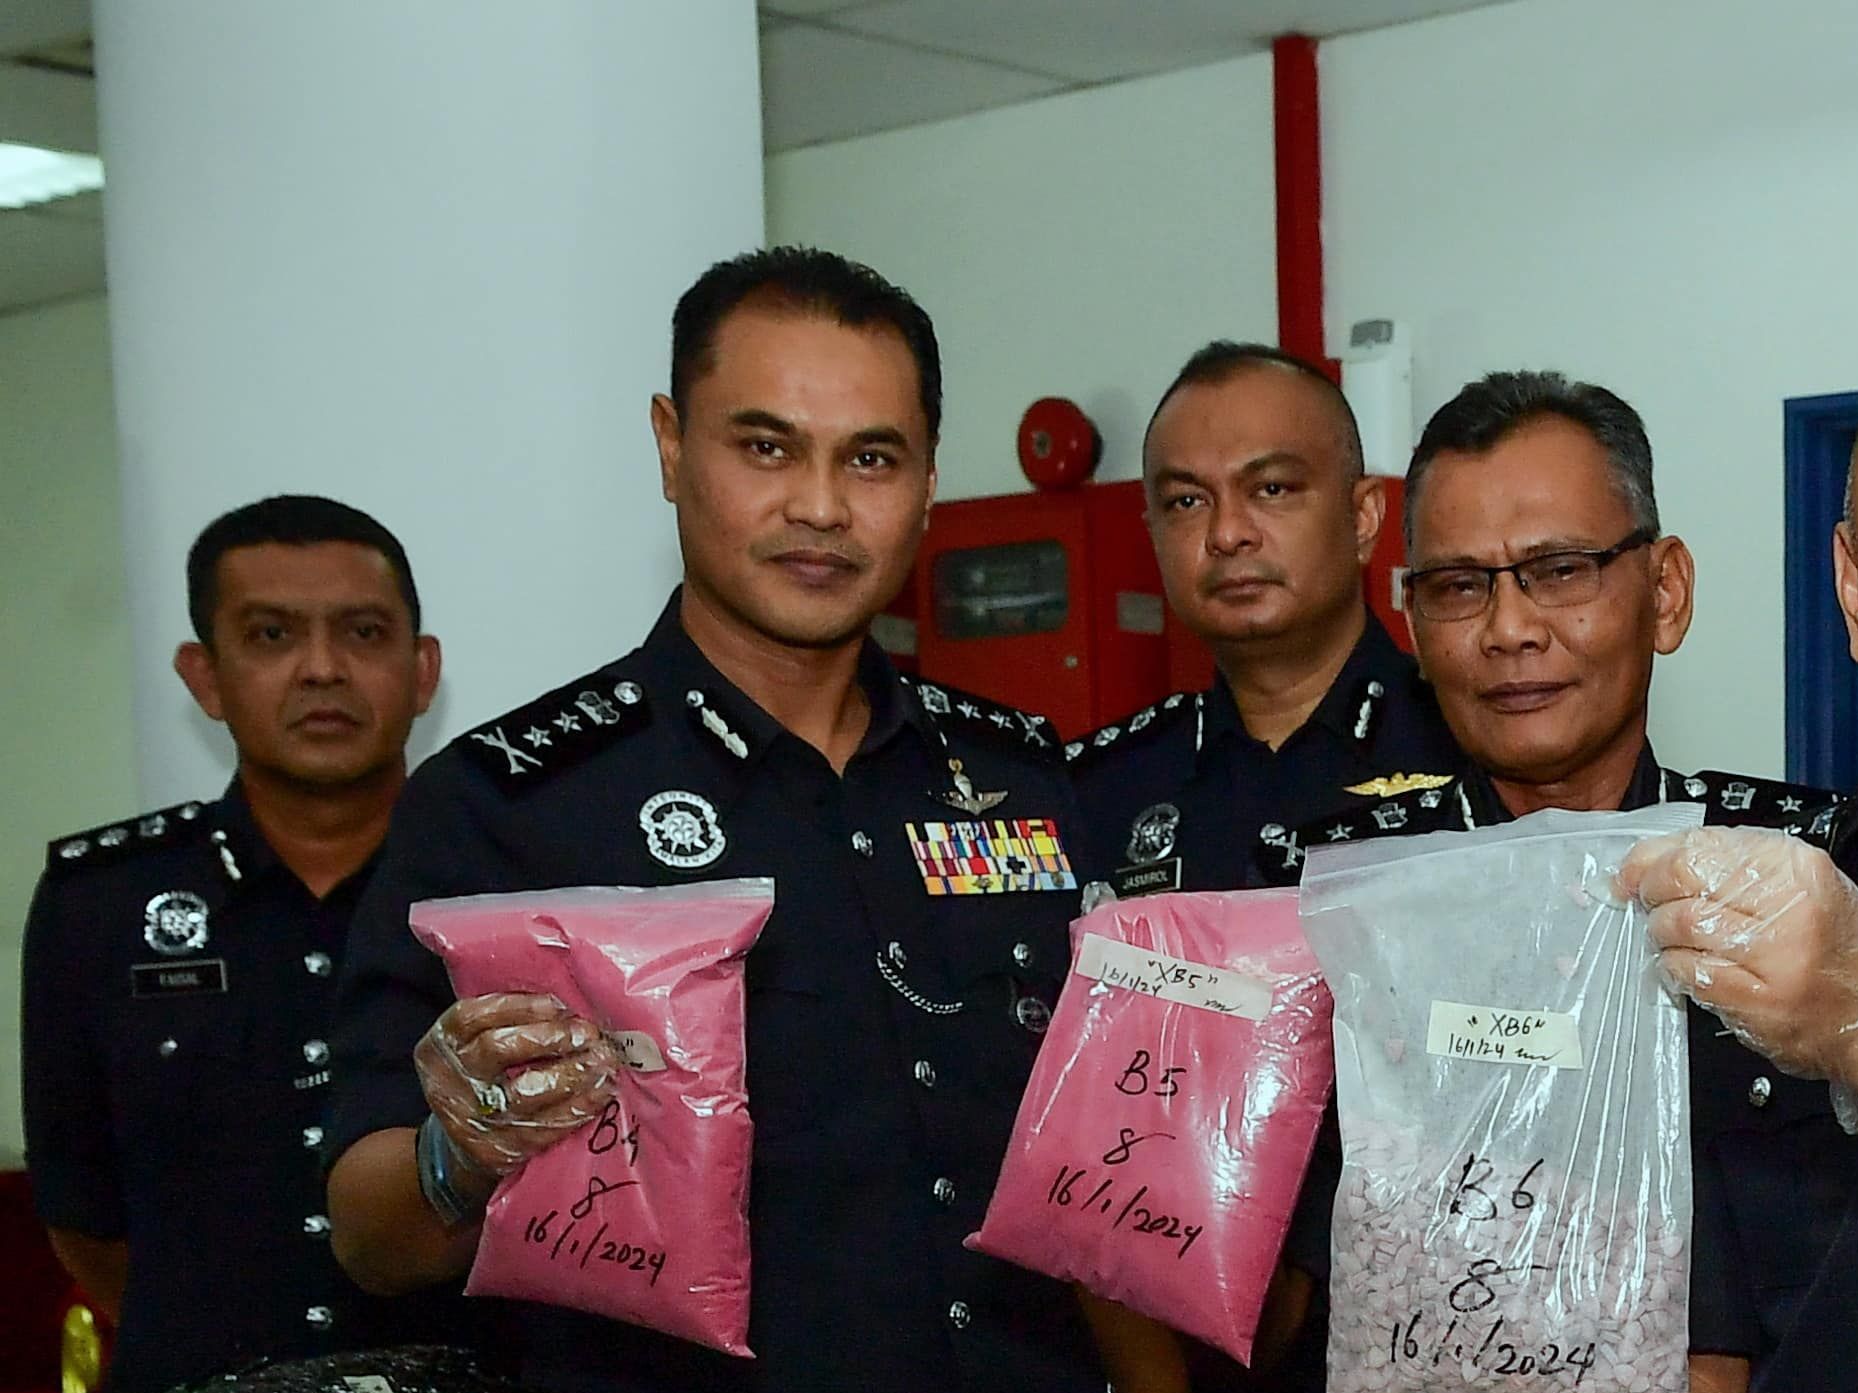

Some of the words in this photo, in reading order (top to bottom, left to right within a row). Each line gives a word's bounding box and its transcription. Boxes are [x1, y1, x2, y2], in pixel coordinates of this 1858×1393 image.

[1449, 1033, 1505, 1059] 16/1/24
[1048, 1165, 1203, 1258] 16/1/2024
[525, 1213, 666, 1286] 16/1/2024
